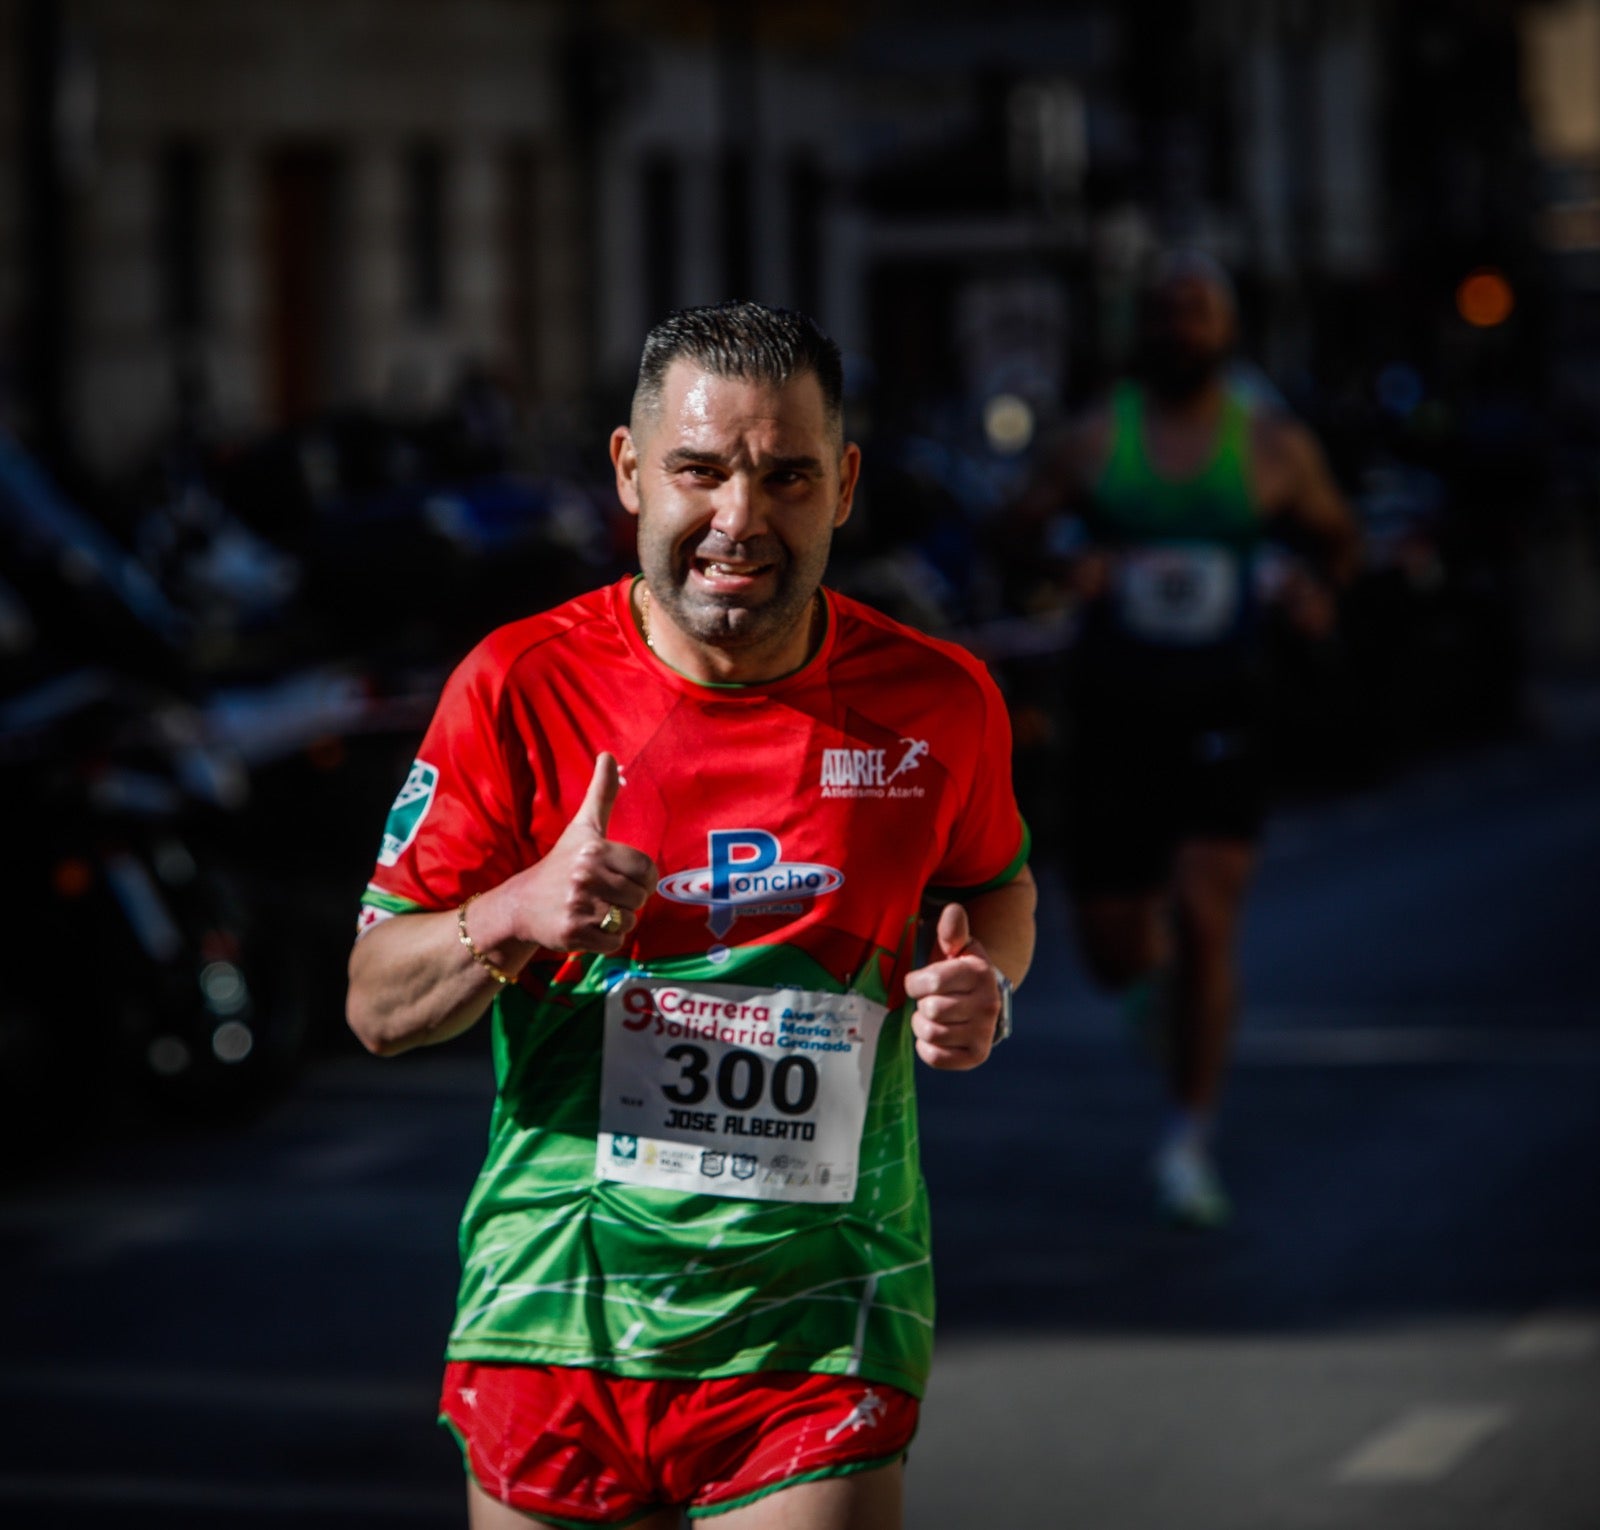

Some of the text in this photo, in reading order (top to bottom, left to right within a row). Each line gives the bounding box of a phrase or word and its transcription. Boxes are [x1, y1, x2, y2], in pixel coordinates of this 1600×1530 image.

[820, 748, 886, 786] ATARFE
[821, 786, 925, 798] Atletismo Atarfe
[708, 828, 821, 900] Poncho
[660, 991, 770, 1022] Carrera
[781, 1008, 815, 1022] Ave
[654, 1017, 775, 1047] Solidaria
[777, 1035, 852, 1053] Granada
[661, 1044, 818, 1115] 300
[664, 1109, 816, 1142] JOSE ALBERTO
